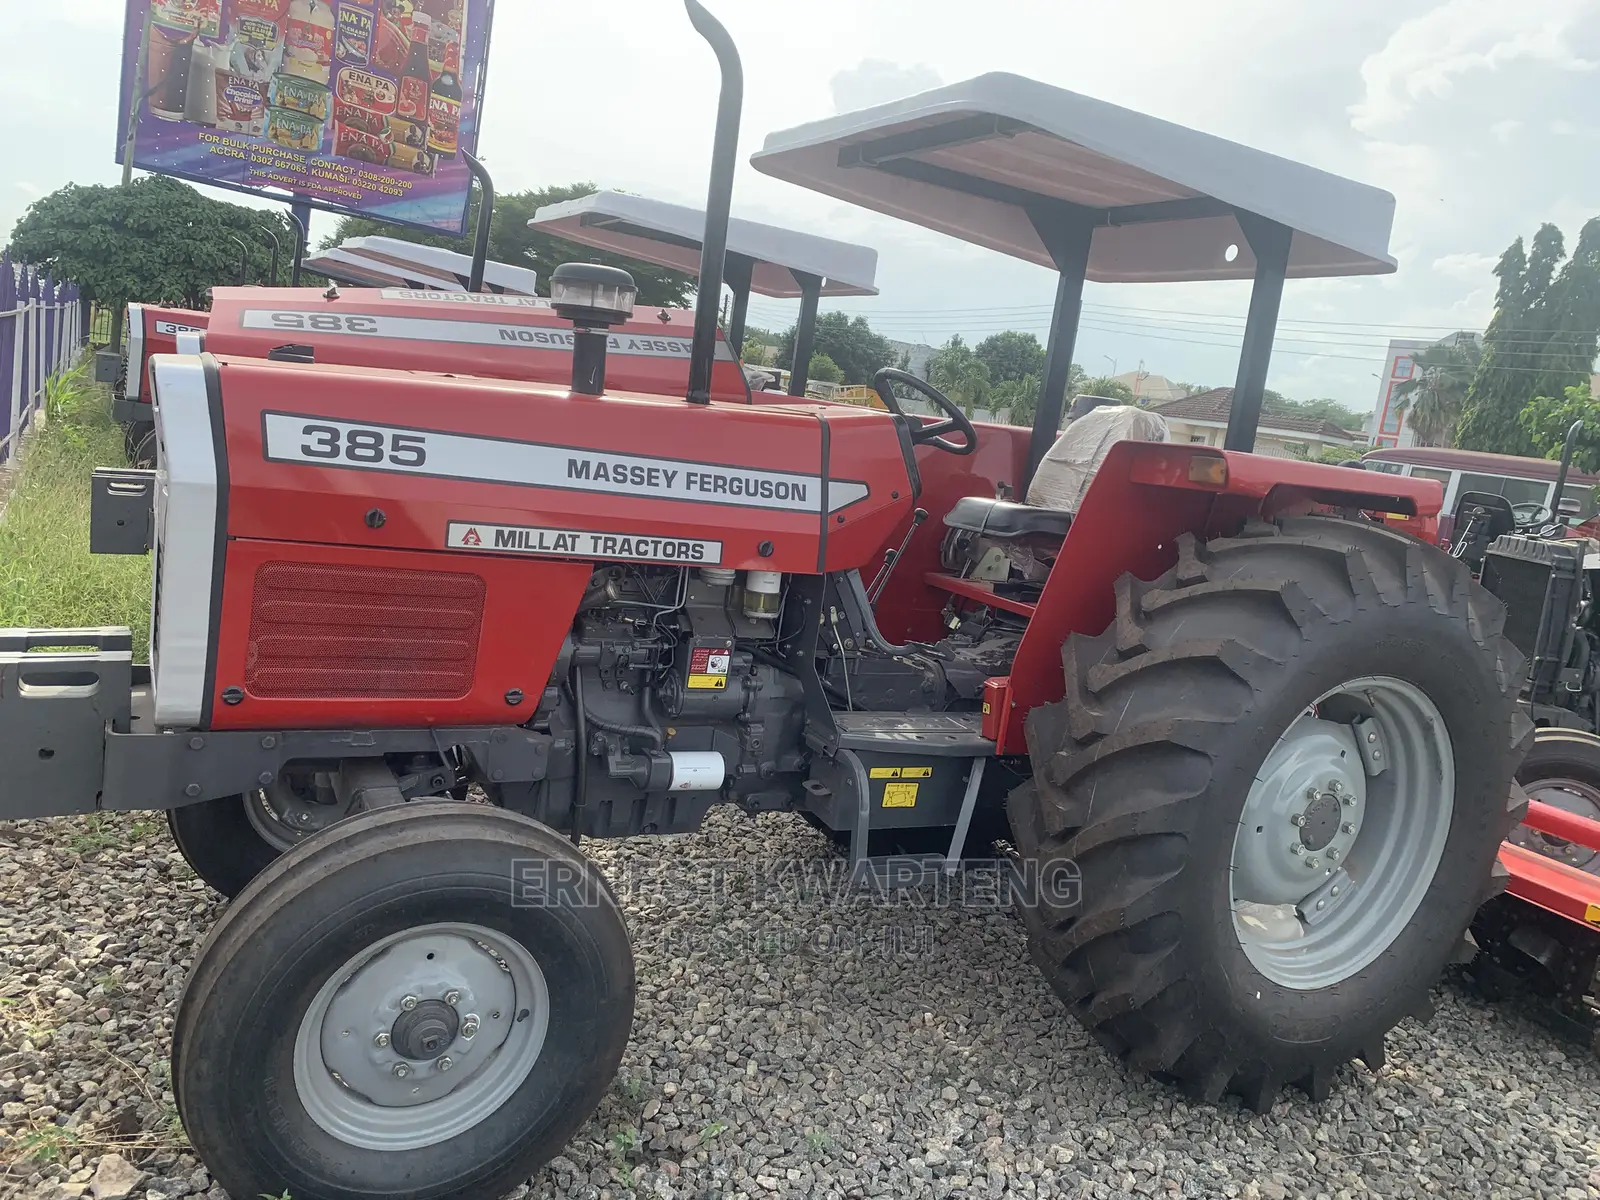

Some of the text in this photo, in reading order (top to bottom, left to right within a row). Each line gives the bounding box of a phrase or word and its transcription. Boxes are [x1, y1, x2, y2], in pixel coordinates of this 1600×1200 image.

[228, 76, 260, 90] ENA PA
[348, 71, 372, 86] ENA
[375, 80, 390, 91] PA
[226, 87, 261, 101] Chocolate
[234, 95, 254, 105] Drink
[284, 85, 320, 104] ENA PA
[336, 105, 379, 127] ENA PA
[277, 118, 313, 136] ENA PA
[341, 132, 385, 153] ENA PA
[198, 132, 413, 189] FOR BULK PURCHASE, CONTACT: 0308-200-200
[209, 146, 248, 160] ACCRA:
[251, 153, 273, 166] 0302
[311, 168, 350, 184] KUMASI:
[352, 179, 377, 191] 03220
[378, 185, 404, 197] 42093
[249, 168, 266, 178] THIS
[267, 173, 298, 185] ADVERT
[306, 182, 322, 190] FDA
[323, 186, 363, 200] APPROVED
[399, 291, 509, 305] TRACTORS
[271, 312, 378, 333] 385
[498, 328, 692, 353] ASSEY FGUSON
[301, 424, 426, 467] 385
[567, 458, 807, 502] MASSEY FERGUSON
[494, 529, 705, 560] MILLAT TRACTORS
